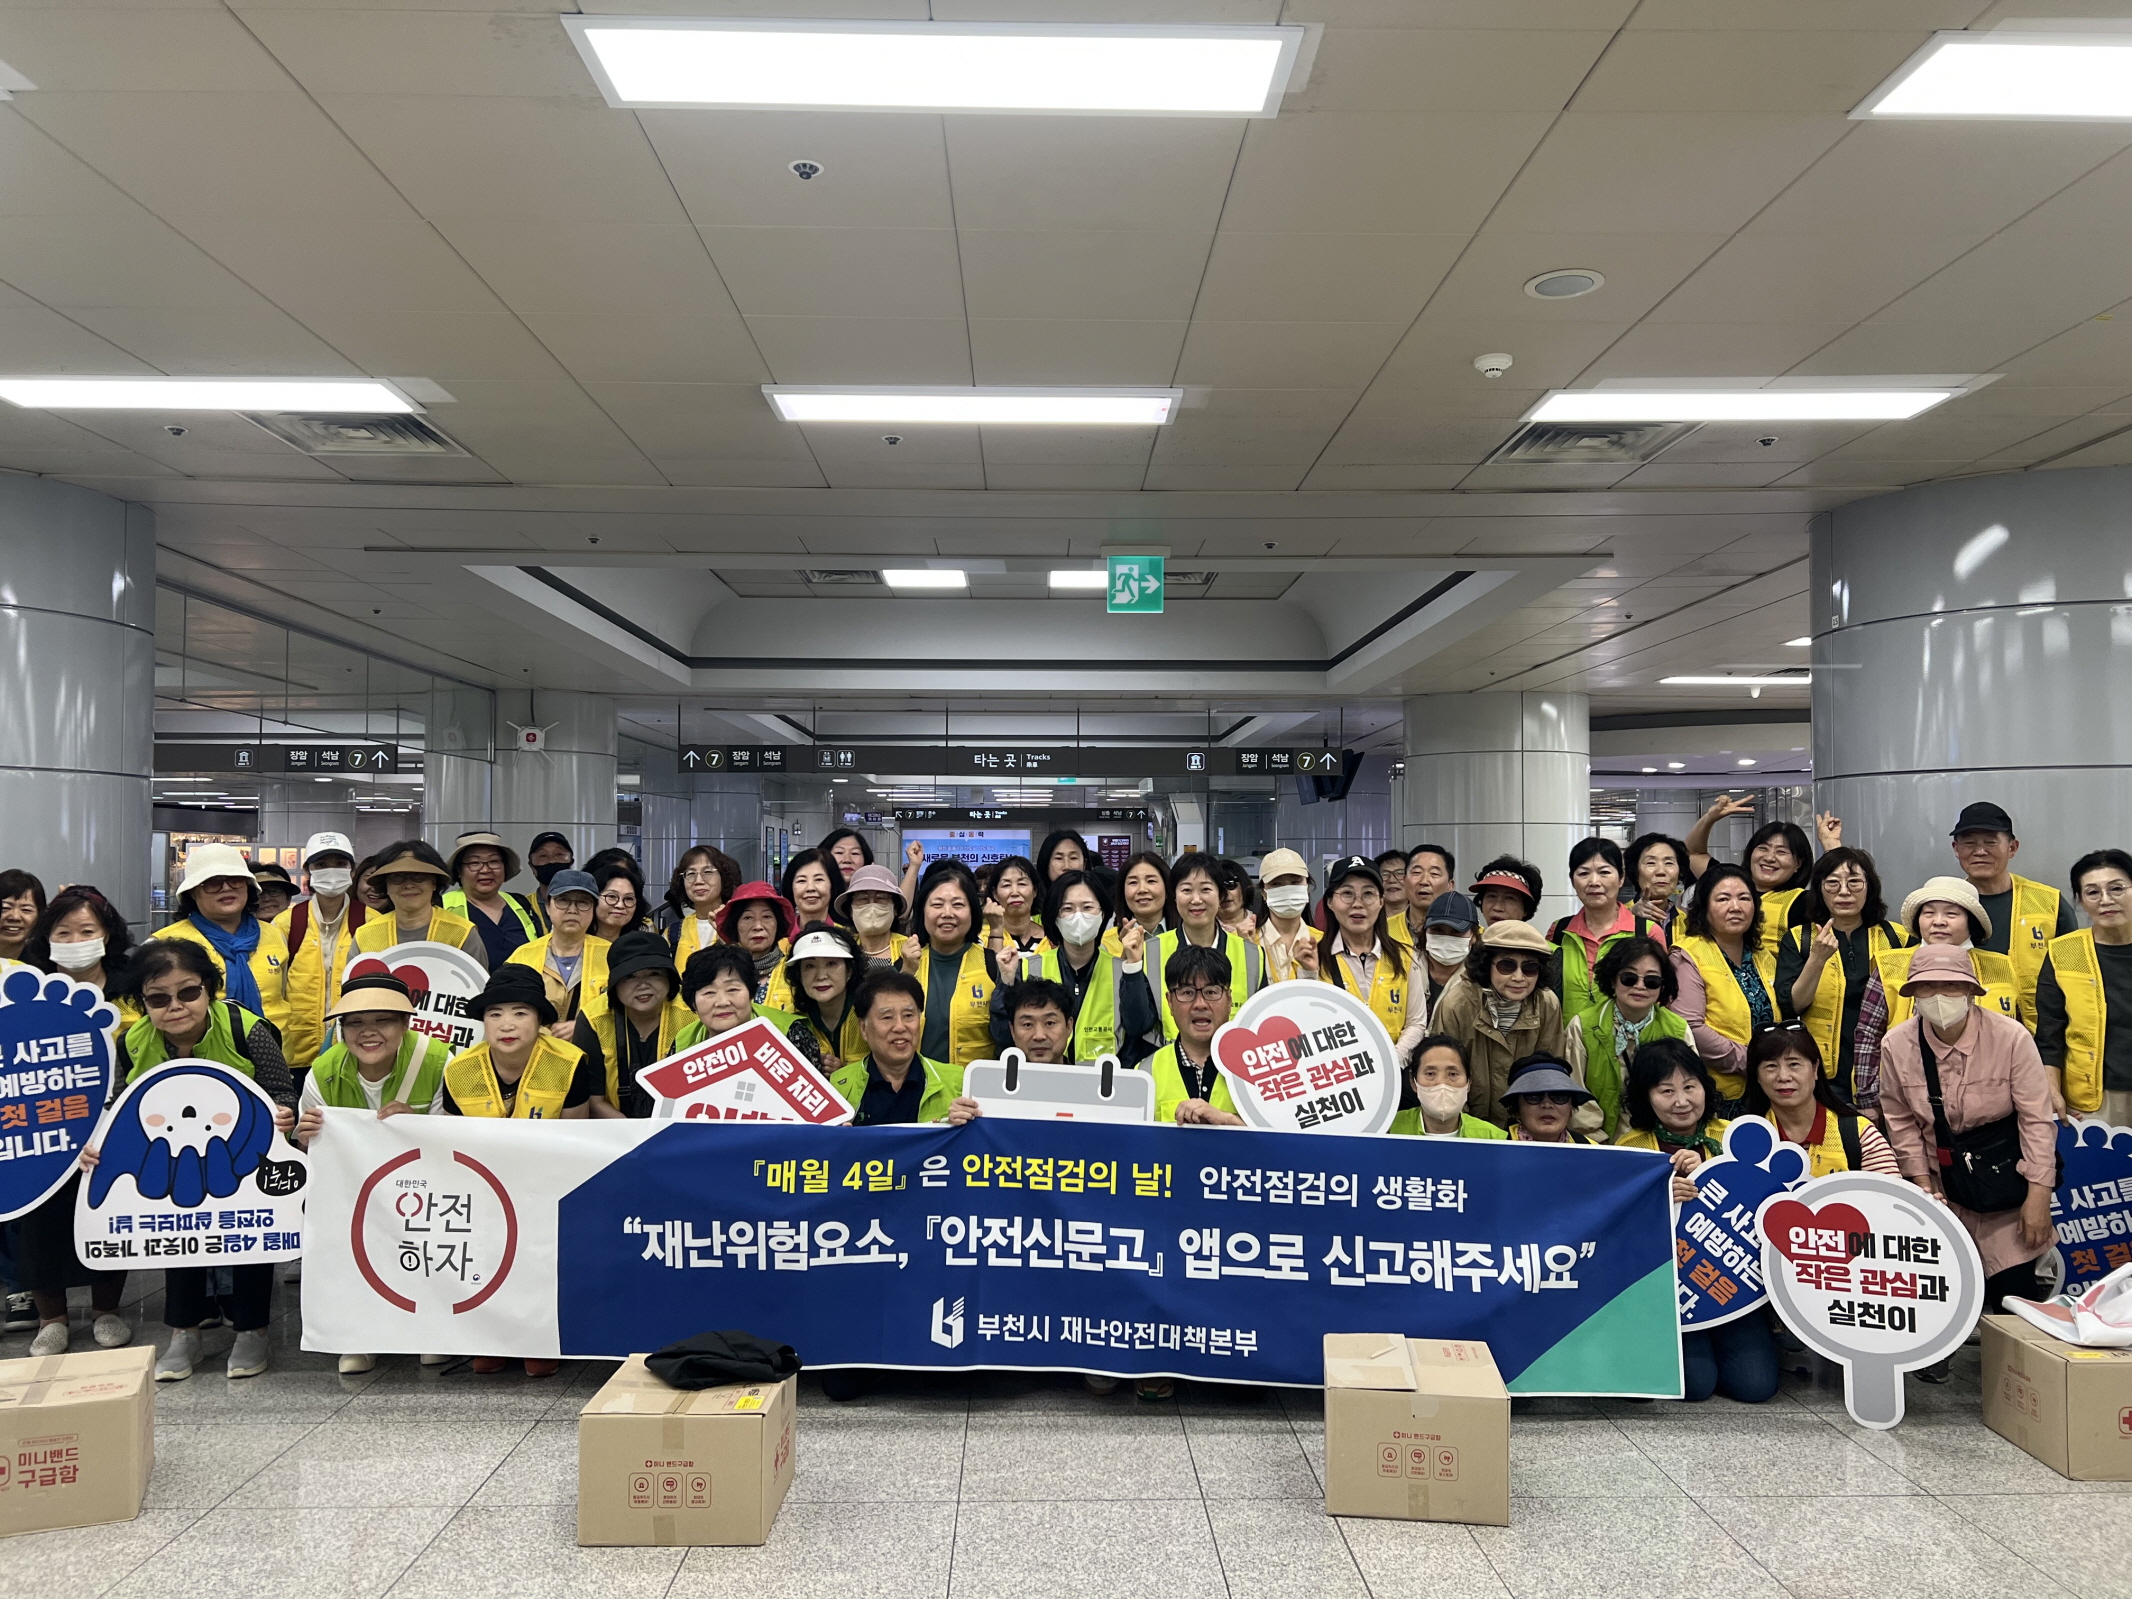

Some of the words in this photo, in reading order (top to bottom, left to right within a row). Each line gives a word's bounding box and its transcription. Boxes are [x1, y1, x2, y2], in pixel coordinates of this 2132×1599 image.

[290, 751, 308, 761] 장암
[321, 751, 339, 761] 석남
[732, 751, 750, 761] 장암
[763, 751, 782, 761] 석남
[974, 753, 1000, 768] 타는
[1004, 753, 1017, 768] 곳
[1026, 753, 1051, 761] Tracks
[1241, 754, 1259, 763] 장암
[1271, 754, 1289, 763] 석남
[13, 1032, 93, 1065] 사고를
[682, 1040, 749, 1084] 안전이
[1241, 1033, 1314, 1077] 안전에
[1312, 1020, 1359, 1053] 대한
[0, 1064, 100, 1099] 예방하는
[753, 1041, 795, 1084] 비운
[786, 1074, 830, 1118] 자리
[1257, 1071, 1307, 1102] 작은
[1306, 1050, 1376, 1091] 관심과
[0, 1103, 28, 1129] 첫
[35, 1094, 89, 1124] 걸음
[1294, 1087, 1365, 1130] 실천이
[395, 1179, 428, 1189] 대한민국
[752, 1157, 831, 1195] 『매월
[918, 1155, 951, 1188] 은
[962, 1153, 1118, 1197] 안전점검의
[1132, 1162, 1173, 1199] 날!
[1199, 1165, 1359, 1208] 안전점검의
[1371, 1174, 1468, 1214] 생활화
[108, 1215, 133, 1234] 날!
[138, 1211, 212, 1233] 살펴보는
[218, 1208, 274, 1229] 안전을
[395, 1191, 473, 1233] 안전
[1698, 1178, 1729, 1211] 큰
[1721, 1203, 1761, 1249] 사고
[2056, 1209, 2132, 1245] 예방하
[84, 1240, 139, 1259] 가족의
[144, 1237, 199, 1256] 이웃과
[204, 1234, 258, 1254] 4일은
[263, 1231, 300, 1251] 매월
[926, 1215, 1164, 1277] 『안전신문고』
[1179, 1228, 1309, 1282] 앱으로
[1321, 1234, 1596, 1294] 신고해주세요”
[1685, 1212, 1763, 1292] 예방하는
[1789, 1226, 1876, 1259] 안전에
[1883, 1234, 1941, 1265] 대한
[2070, 1248, 2101, 1275] 첫
[2103, 1241, 2132, 1269] 걸
[1688, 1258, 1739, 1306] 걸음
[1795, 1262, 1852, 1292] 작은
[1859, 1268, 1949, 1302] 관심과
[1827, 1299, 1917, 1333] 실천이
[977, 1313, 1050, 1343] 부천시
[1061, 1315, 1258, 1359] 재난안전대책본부
[18, 1447, 79, 1467] 미니밴드
[17, 1464, 80, 1489] 구급함
